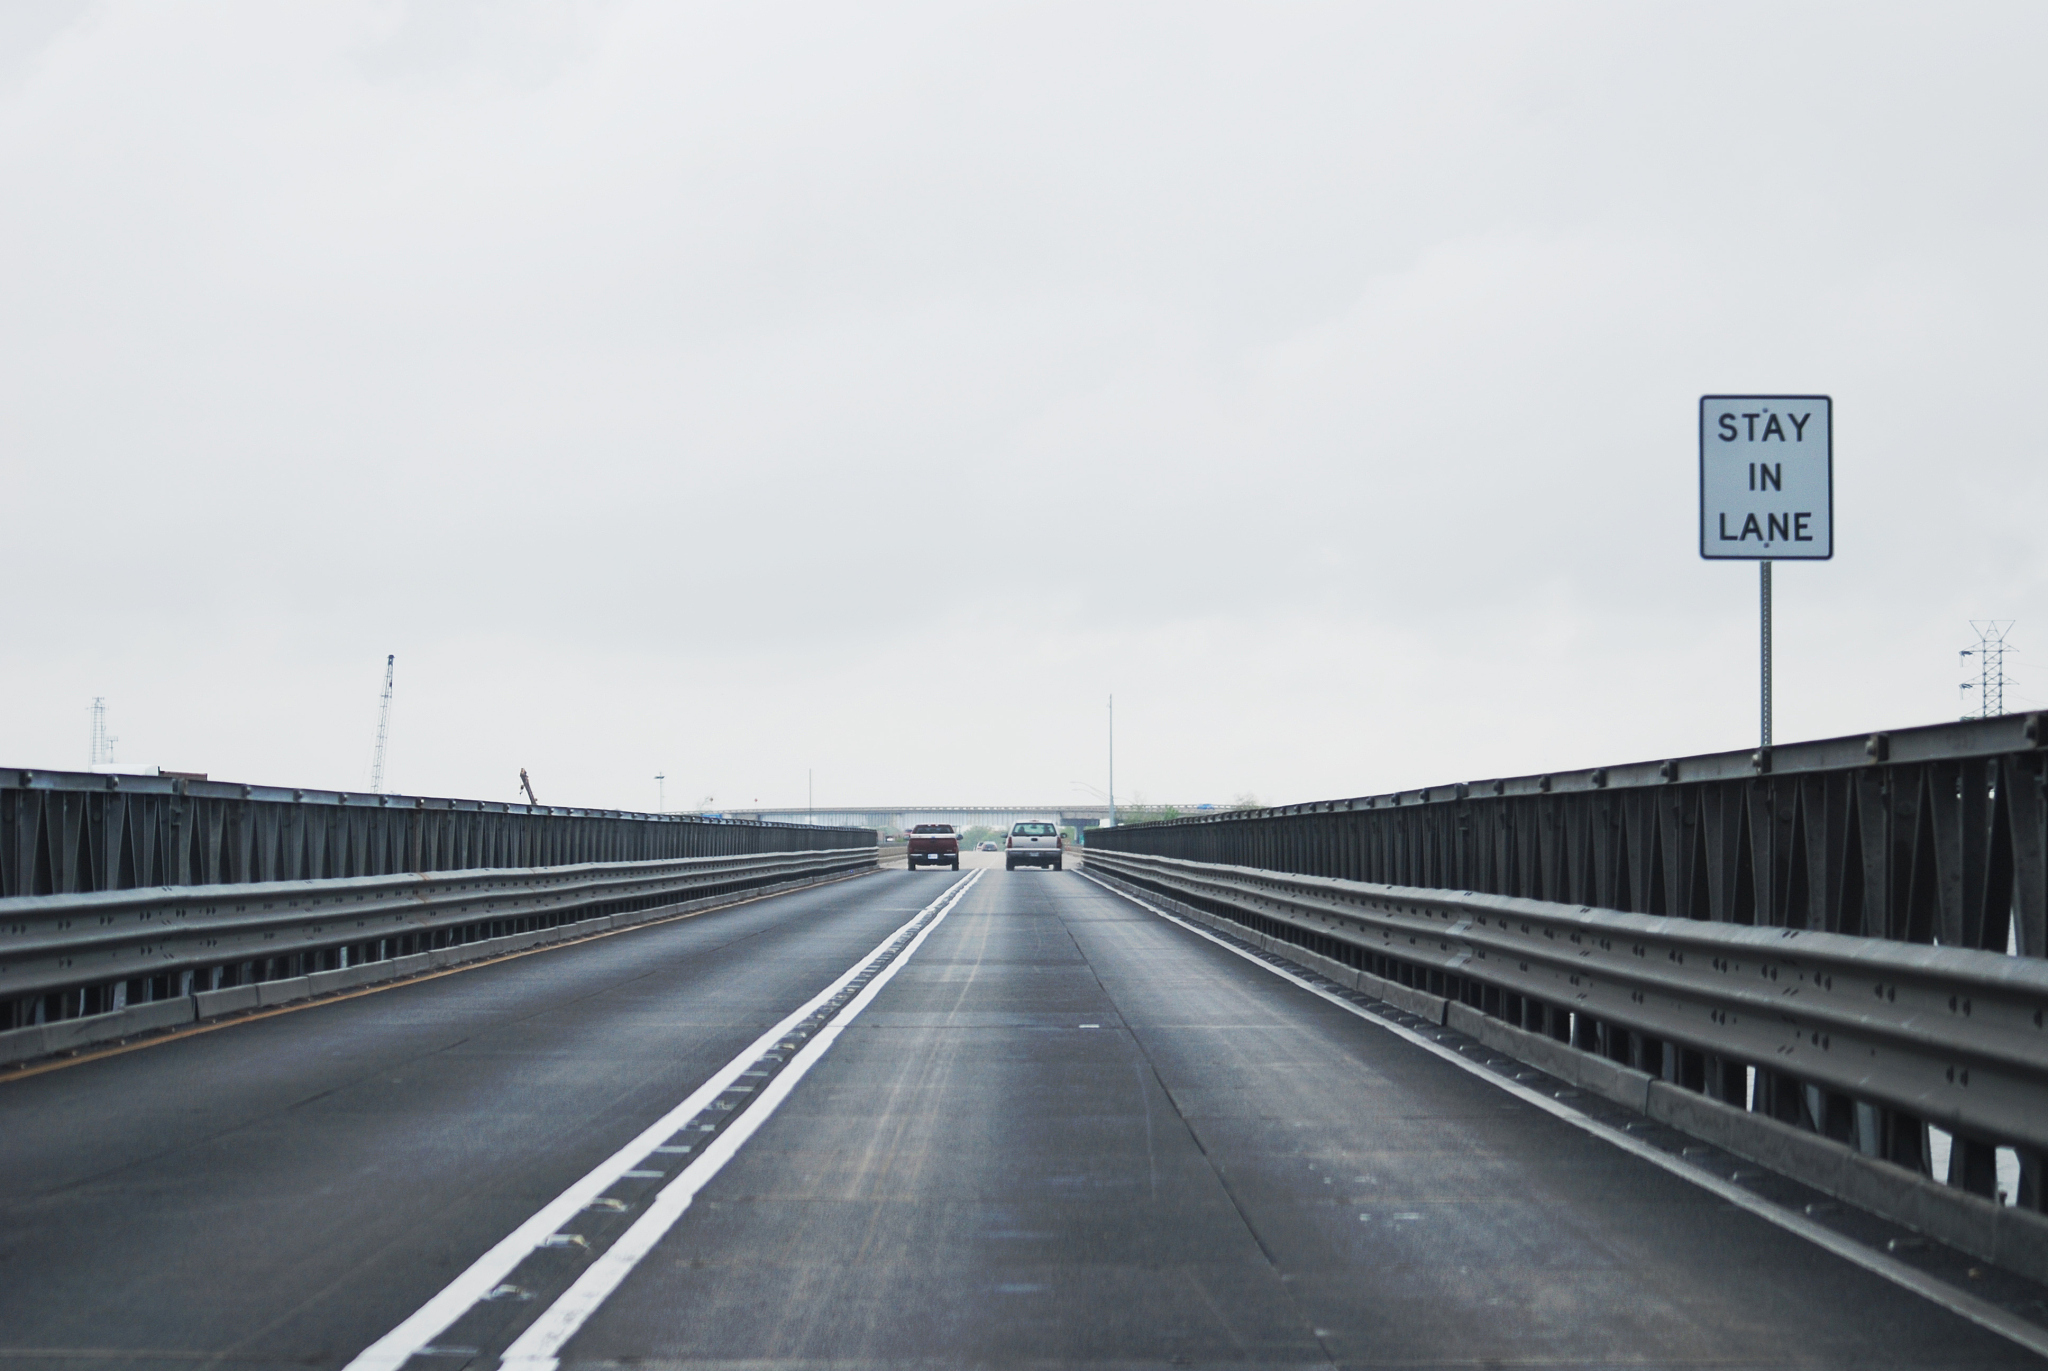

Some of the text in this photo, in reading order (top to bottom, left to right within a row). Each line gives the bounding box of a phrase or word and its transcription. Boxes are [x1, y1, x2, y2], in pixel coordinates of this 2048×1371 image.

[1718, 412, 1811, 442] STAY
[1749, 462, 1781, 491] IN
[1719, 512, 1813, 541] LANE
